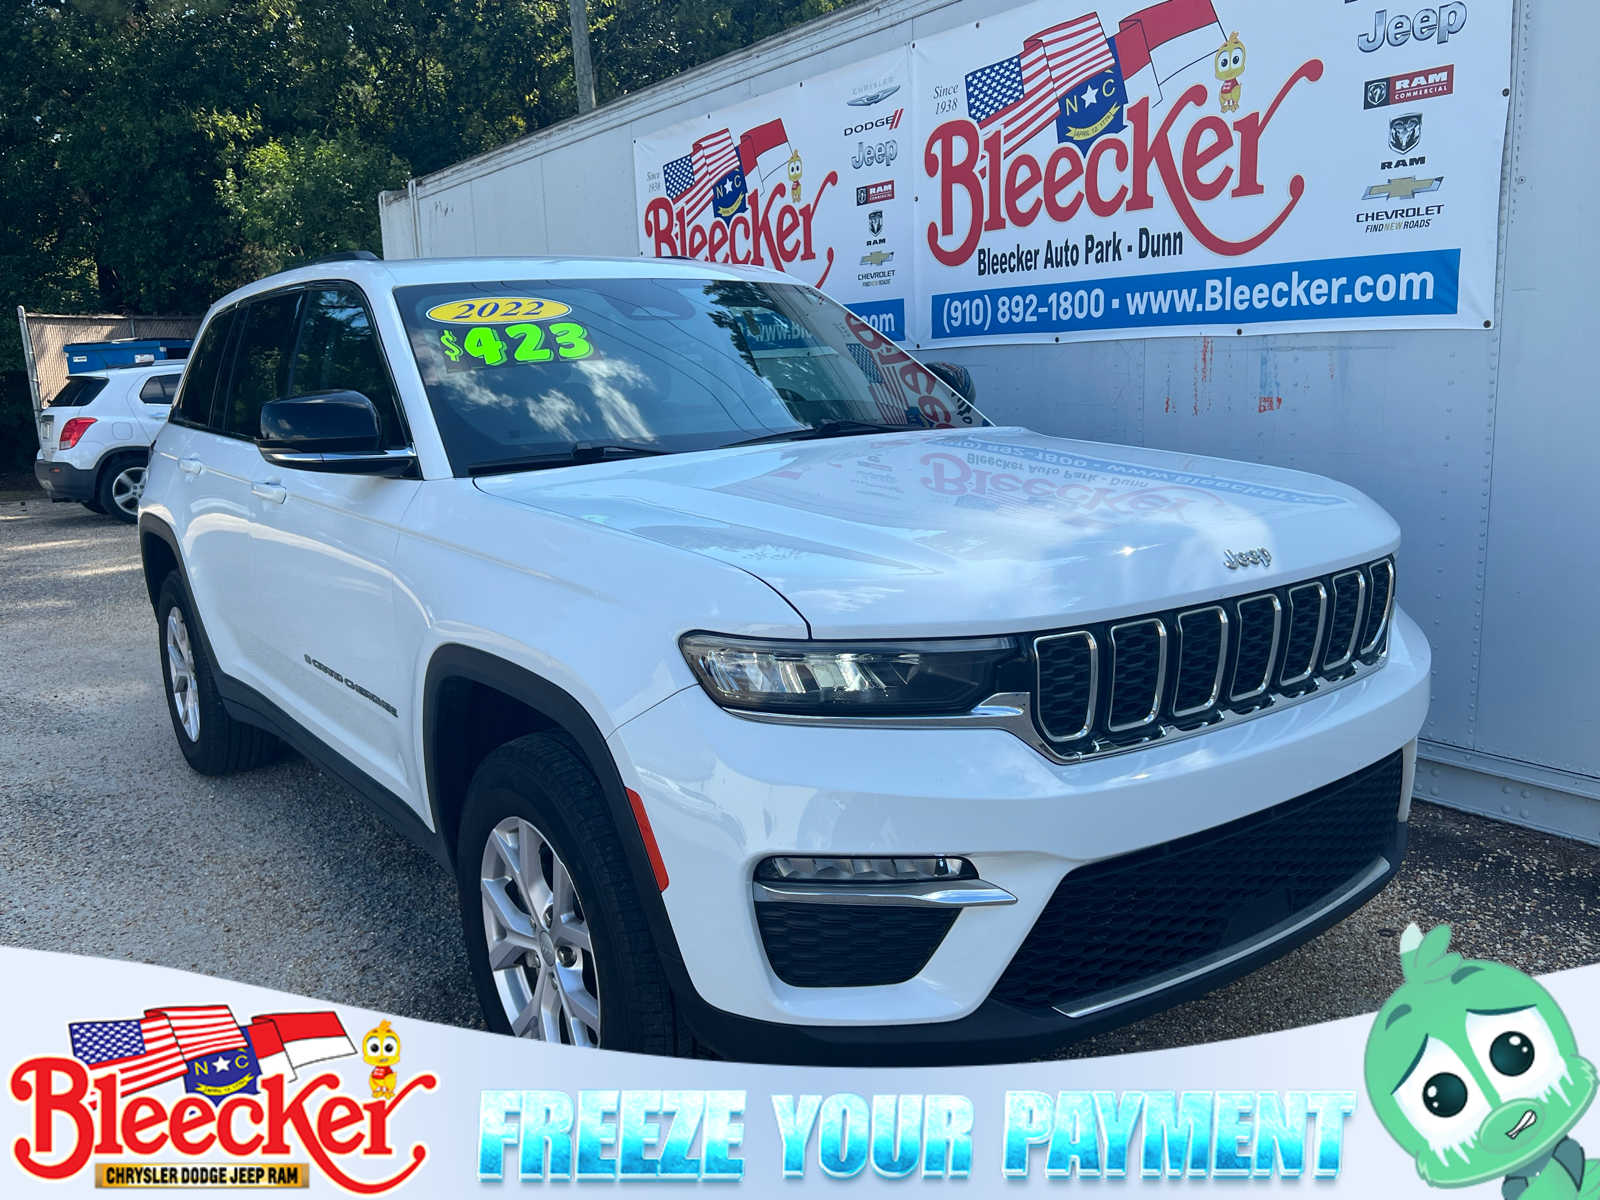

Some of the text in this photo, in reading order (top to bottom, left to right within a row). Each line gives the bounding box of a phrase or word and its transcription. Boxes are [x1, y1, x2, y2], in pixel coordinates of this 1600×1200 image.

[1357, 0, 1467, 53] Jeep
[1395, 71, 1448, 90] RAM
[933, 84, 959, 99] Since
[1065, 78, 1116, 116] N C
[1394, 85, 1448, 100] COMMERCIAL
[935, 100, 959, 115] 1938
[844, 115, 895, 136] DODGE
[851, 139, 898, 169] Jeep
[924, 59, 1323, 266] Bleecker
[1380, 156, 1426, 170] RAM
[870, 183, 892, 195] RAM
[1356, 204, 1444, 223] CHEVROLET
[645, 170, 838, 288] Bleecker
[1365, 222, 1384, 233] FIND
[1403, 218, 1431, 230] ROADS
[866, 238, 886, 247] RAM
[977, 227, 1183, 276] Bleecker Auto Park Dunn
[857, 270, 896, 281] CHEVROLET
[452, 301, 544, 320] 2022
[943, 269, 1435, 333] (910) 892-1800 www.Bleecker.com
[440, 322, 594, 366] $423
[1223, 547, 1273, 571] Jeep
